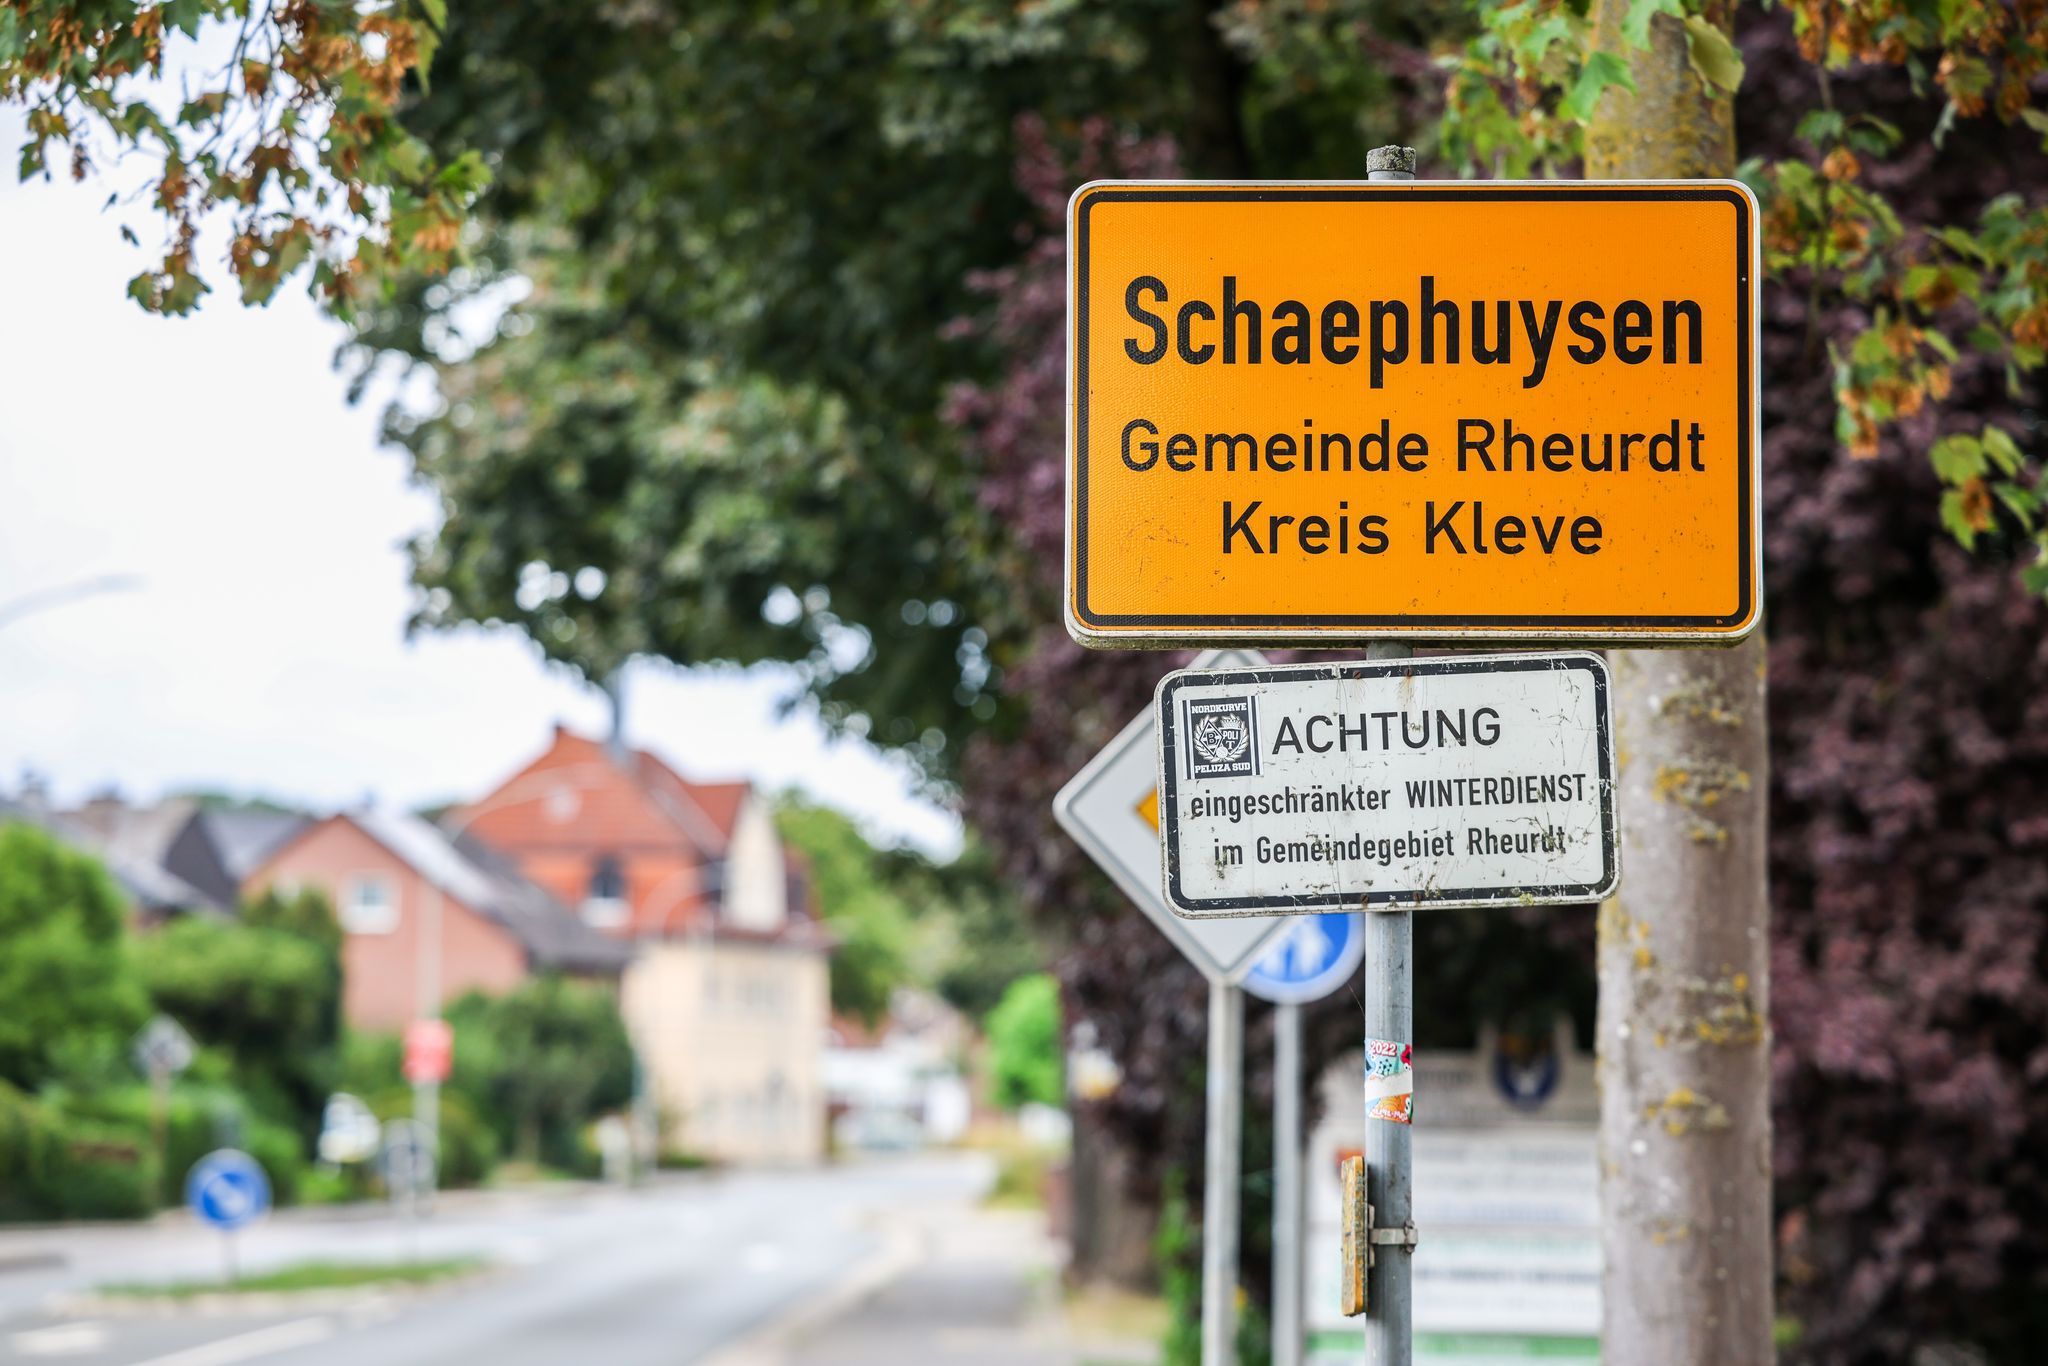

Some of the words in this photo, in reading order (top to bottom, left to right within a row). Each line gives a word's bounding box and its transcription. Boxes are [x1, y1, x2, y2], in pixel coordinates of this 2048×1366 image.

[1124, 275, 1703, 389] Schaephuysen
[1121, 418, 1429, 473] Gemeinde
[1457, 418, 1705, 473] Rheurdt
[1222, 501, 1390, 555] Kreis
[1425, 501, 1603, 555] Kleve
[1191, 702, 1247, 713] NORDKURVE
[1206, 732, 1216, 745] B
[1222, 730, 1238, 739] POLI
[1225, 740, 1236, 750] T
[1271, 707, 1501, 755] ACHTUNG
[1195, 764, 1231, 773] PELUZA
[1232, 762, 1250, 771] SUD
[1190, 783, 1391, 824] eingeschränkter
[1404, 773, 1587, 809] WINTERDIENST
[1213, 838, 1244, 866] im
[1255, 830, 1455, 867] Gemeindegebiet
[1467, 824, 1567, 856] Rheurdt
[1370, 1040, 1398, 1057] 2022
